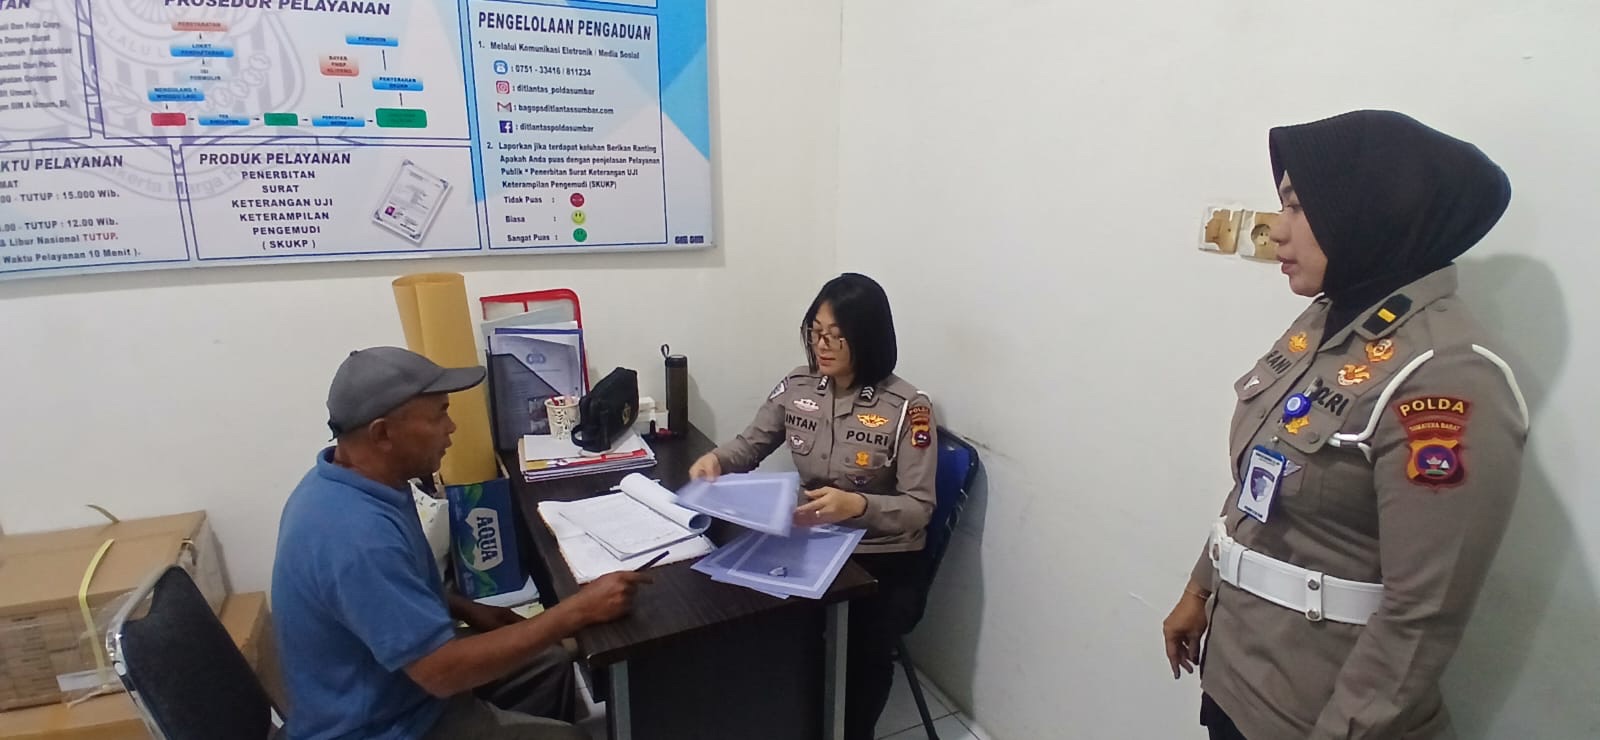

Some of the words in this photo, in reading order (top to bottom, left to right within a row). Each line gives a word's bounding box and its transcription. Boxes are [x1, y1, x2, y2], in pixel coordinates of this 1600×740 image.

[164, 0, 272, 8] PROSEDUR
[278, 0, 390, 15] PELAYANAN
[478, 11, 574, 35] PENGELOLAAN
[578, 20, 652, 41] PENGADUAN
[490, 41, 517, 51] Melalui
[518, 43, 561, 54] Komunikasi
[598, 48, 618, 59] Media
[619, 50, 640, 60] Sosial
[515, 64, 533, 73] 0751
[539, 65, 561, 75] 33416
[566, 67, 591, 76] 811234
[486, 141, 494, 149] 2.
[498, 142, 532, 151] Laporkan
[548, 143, 578, 152] terdapat
[579, 143, 605, 151] keluhan
[606, 144, 632, 152] Berikan
[35, 155, 123, 170] PELAYANAN
[199, 153, 261, 165] PRODUK
[266, 153, 351, 164] PELAYANAN
[500, 154, 527, 164] Apakah
[528, 155, 547, 163] Anda
[566, 156, 590, 165] dengan
[592, 156, 627, 165] penjelasan
[628, 156, 660, 166] Pelayanan
[241, 170, 316, 180] PENERBITAN
[501, 167, 523, 175] Publik
[530, 167, 567, 175] Penerbitan
[568, 168, 587, 176] Surat
[588, 168, 626, 178] Keterangan
[262, 184, 300, 194] SURAT
[502, 180, 549, 190] Keterampilan
[550, 181, 588, 190] Pengemudi
[589, 180, 617, 189] (SKUKP)
[20, 193, 53, 202] TUTUP
[63, 191, 95, 200] 15.000
[97, 189, 120, 198] Wib.
[504, 195, 523, 203] Tidak
[525, 195, 542, 203] Puas
[231, 199, 311, 208] KETERANGAN
[314, 198, 333, 207] UJI
[239, 211, 330, 222] KETERAMPILAN
[505, 215, 526, 223] Biasa
[24, 220, 57, 230] TUTUP
[67, 218, 94, 228] 12.00
[96, 217, 118, 226] Wib.
[252, 225, 321, 236] PENGEMUDI
[9, 237, 33, 247] Libur
[36, 234, 80, 245] Nasional
[82, 231, 119, 242] TUTUP.
[269, 239, 308, 249] SKUKP
[507, 234, 531, 243] Sangat
[533, 233, 550, 241] Puas
[2, 254, 32, 264] Waktu
[35, 252, 86, 262] Pelayanan
[88, 249, 100, 258] 10
[102, 247, 130, 257] Menit
[1399, 398, 1464, 417] POLDA
[846, 430, 889, 447] POLRI
[476, 516, 498, 563] AQUA
